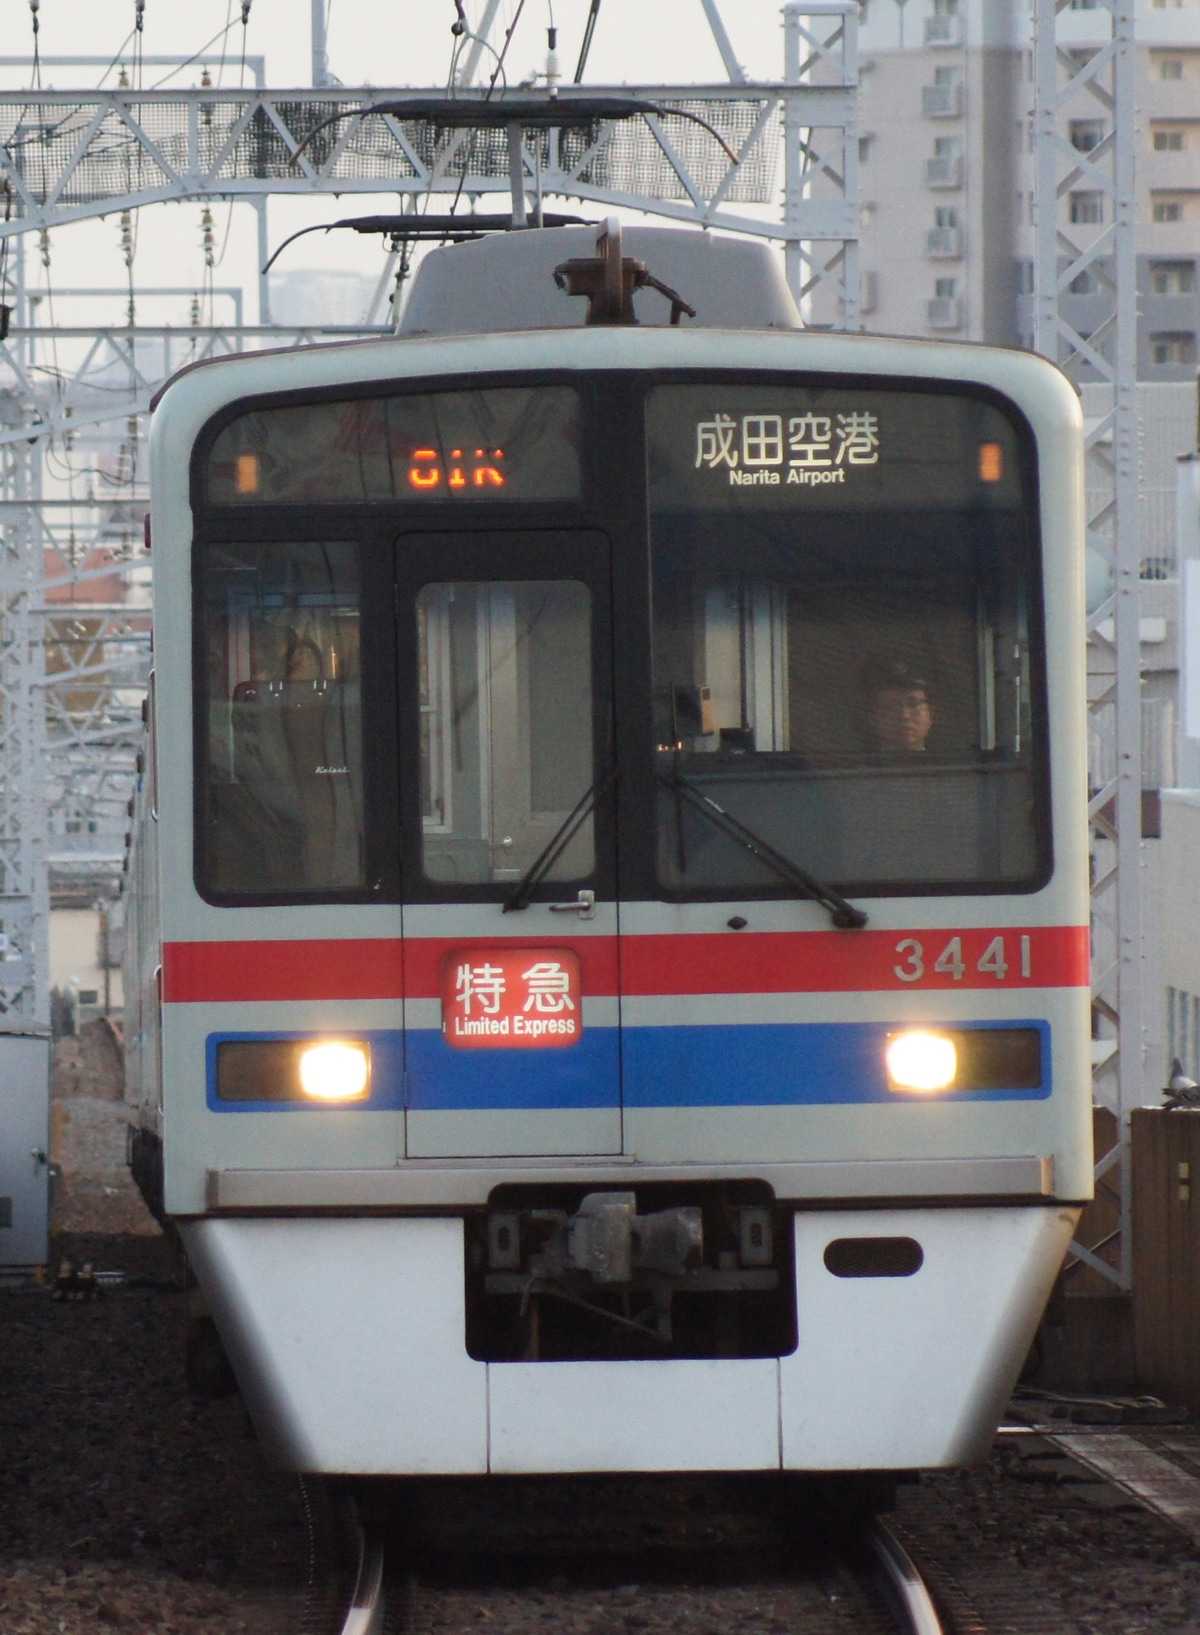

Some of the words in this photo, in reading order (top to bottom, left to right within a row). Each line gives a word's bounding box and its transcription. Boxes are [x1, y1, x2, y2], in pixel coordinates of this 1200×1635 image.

[695, 412, 879, 468] 成田空港
[729, 469, 780, 485] Narita
[787, 468, 845, 486] Airport
[894, 935, 1031, 982] 3441
[456, 963, 575, 1014] 特急
[455, 1016, 509, 1035] Limited
[513, 1015, 576, 1038] Express
